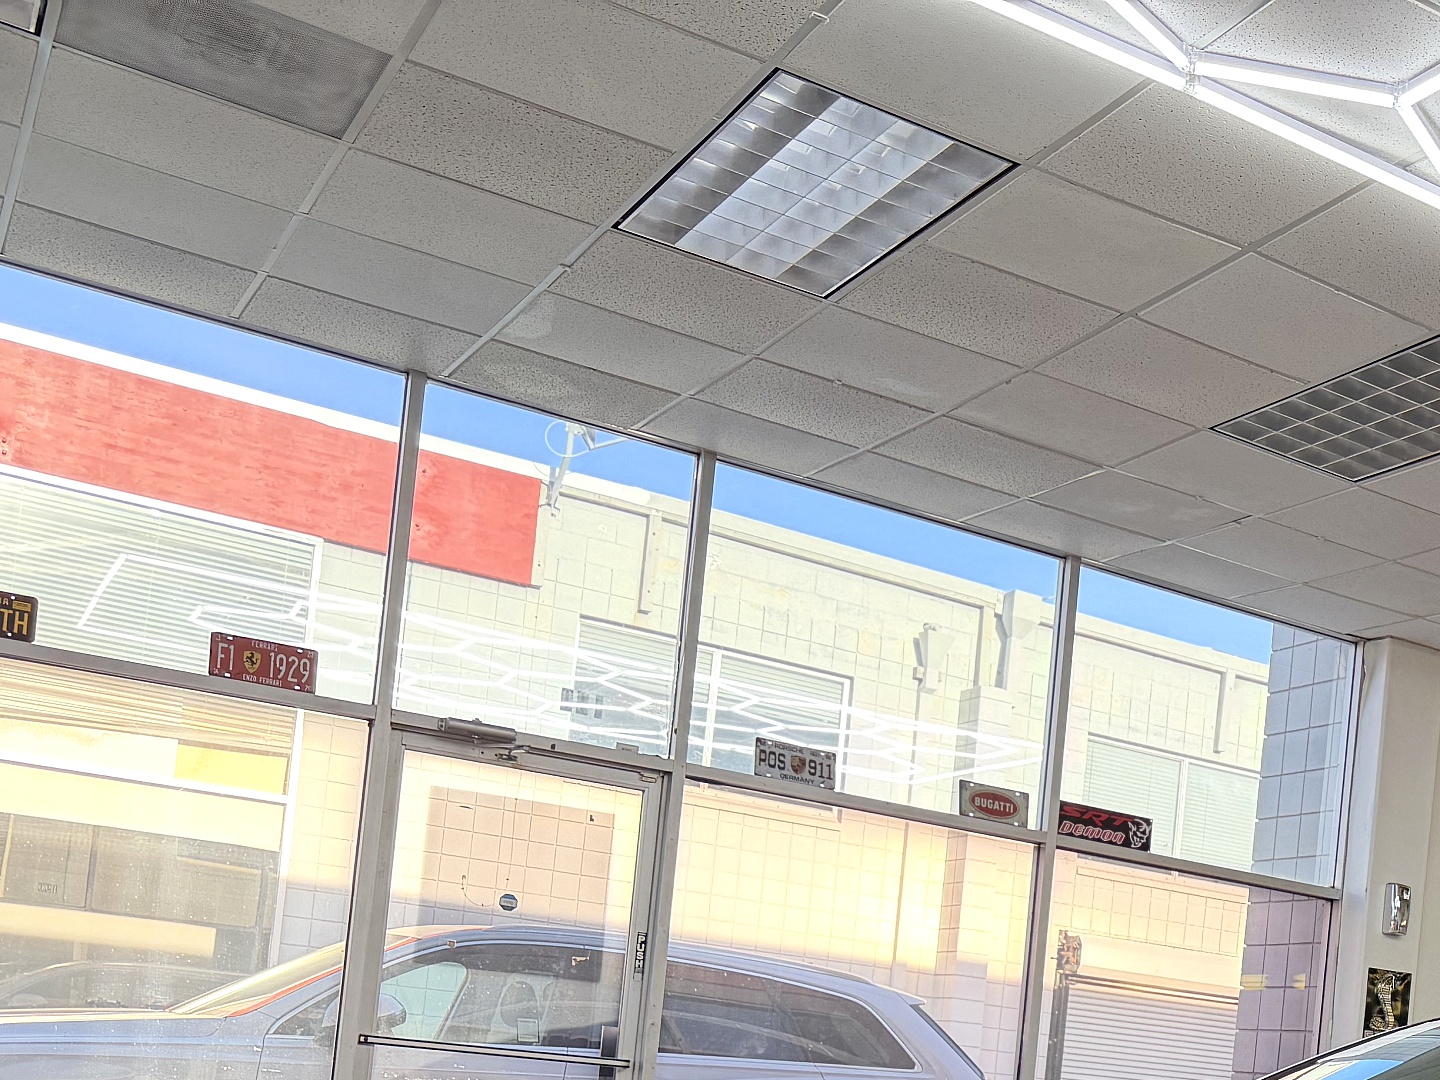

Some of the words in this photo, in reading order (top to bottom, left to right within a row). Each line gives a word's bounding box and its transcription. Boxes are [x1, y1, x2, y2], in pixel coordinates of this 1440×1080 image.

[0, 609, 28, 635] TH
[251, 640, 278, 652] FERRARI
[217, 642, 234, 671] F1
[269, 652, 310, 684] 1929
[242, 673, 257, 682] ENZO
[259, 676, 282, 687] FERRARI
[774, 742, 805, 754] PORSCHE
[758, 749, 786, 771] POS
[808, 759, 834, 780] 911
[780, 773, 815, 785] GERMANY
[974, 796, 1014, 813] BUGATTI
[1061, 804, 1135, 827] SRT
[635, 935, 646, 968] PUSH
